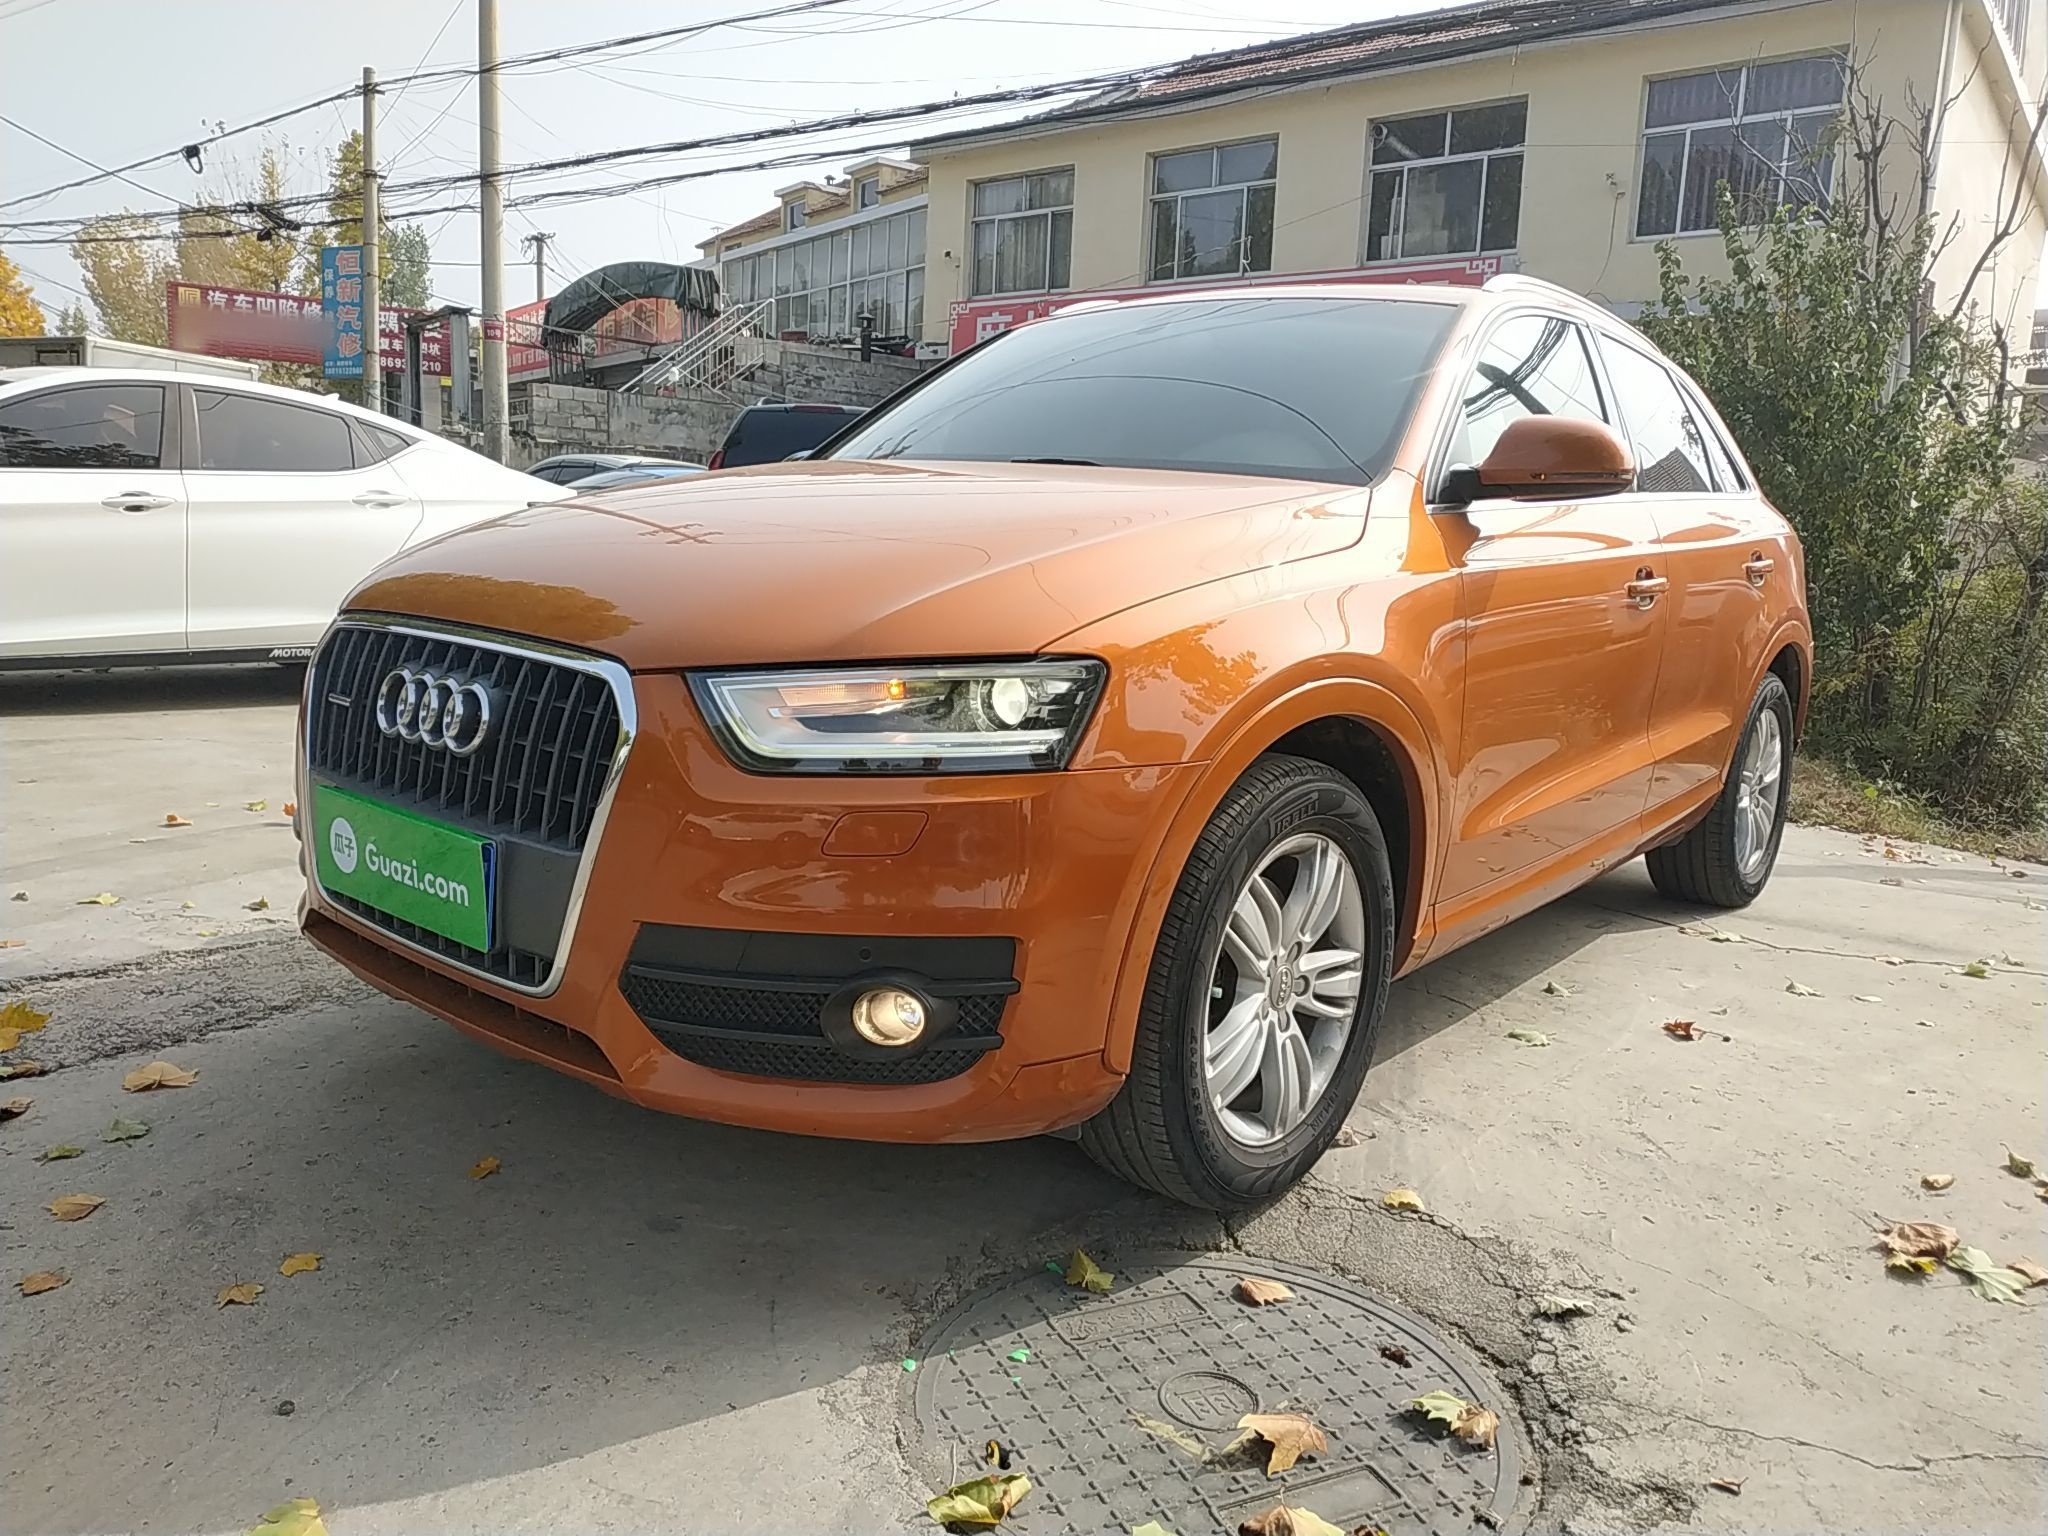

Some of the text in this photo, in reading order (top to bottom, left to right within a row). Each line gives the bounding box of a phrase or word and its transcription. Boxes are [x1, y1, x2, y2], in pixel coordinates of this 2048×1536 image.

[336, 250, 362, 358] 恒新汽修
[333, 832, 355, 858] 瓜子
[365, 841, 469, 907] Guazi.com
